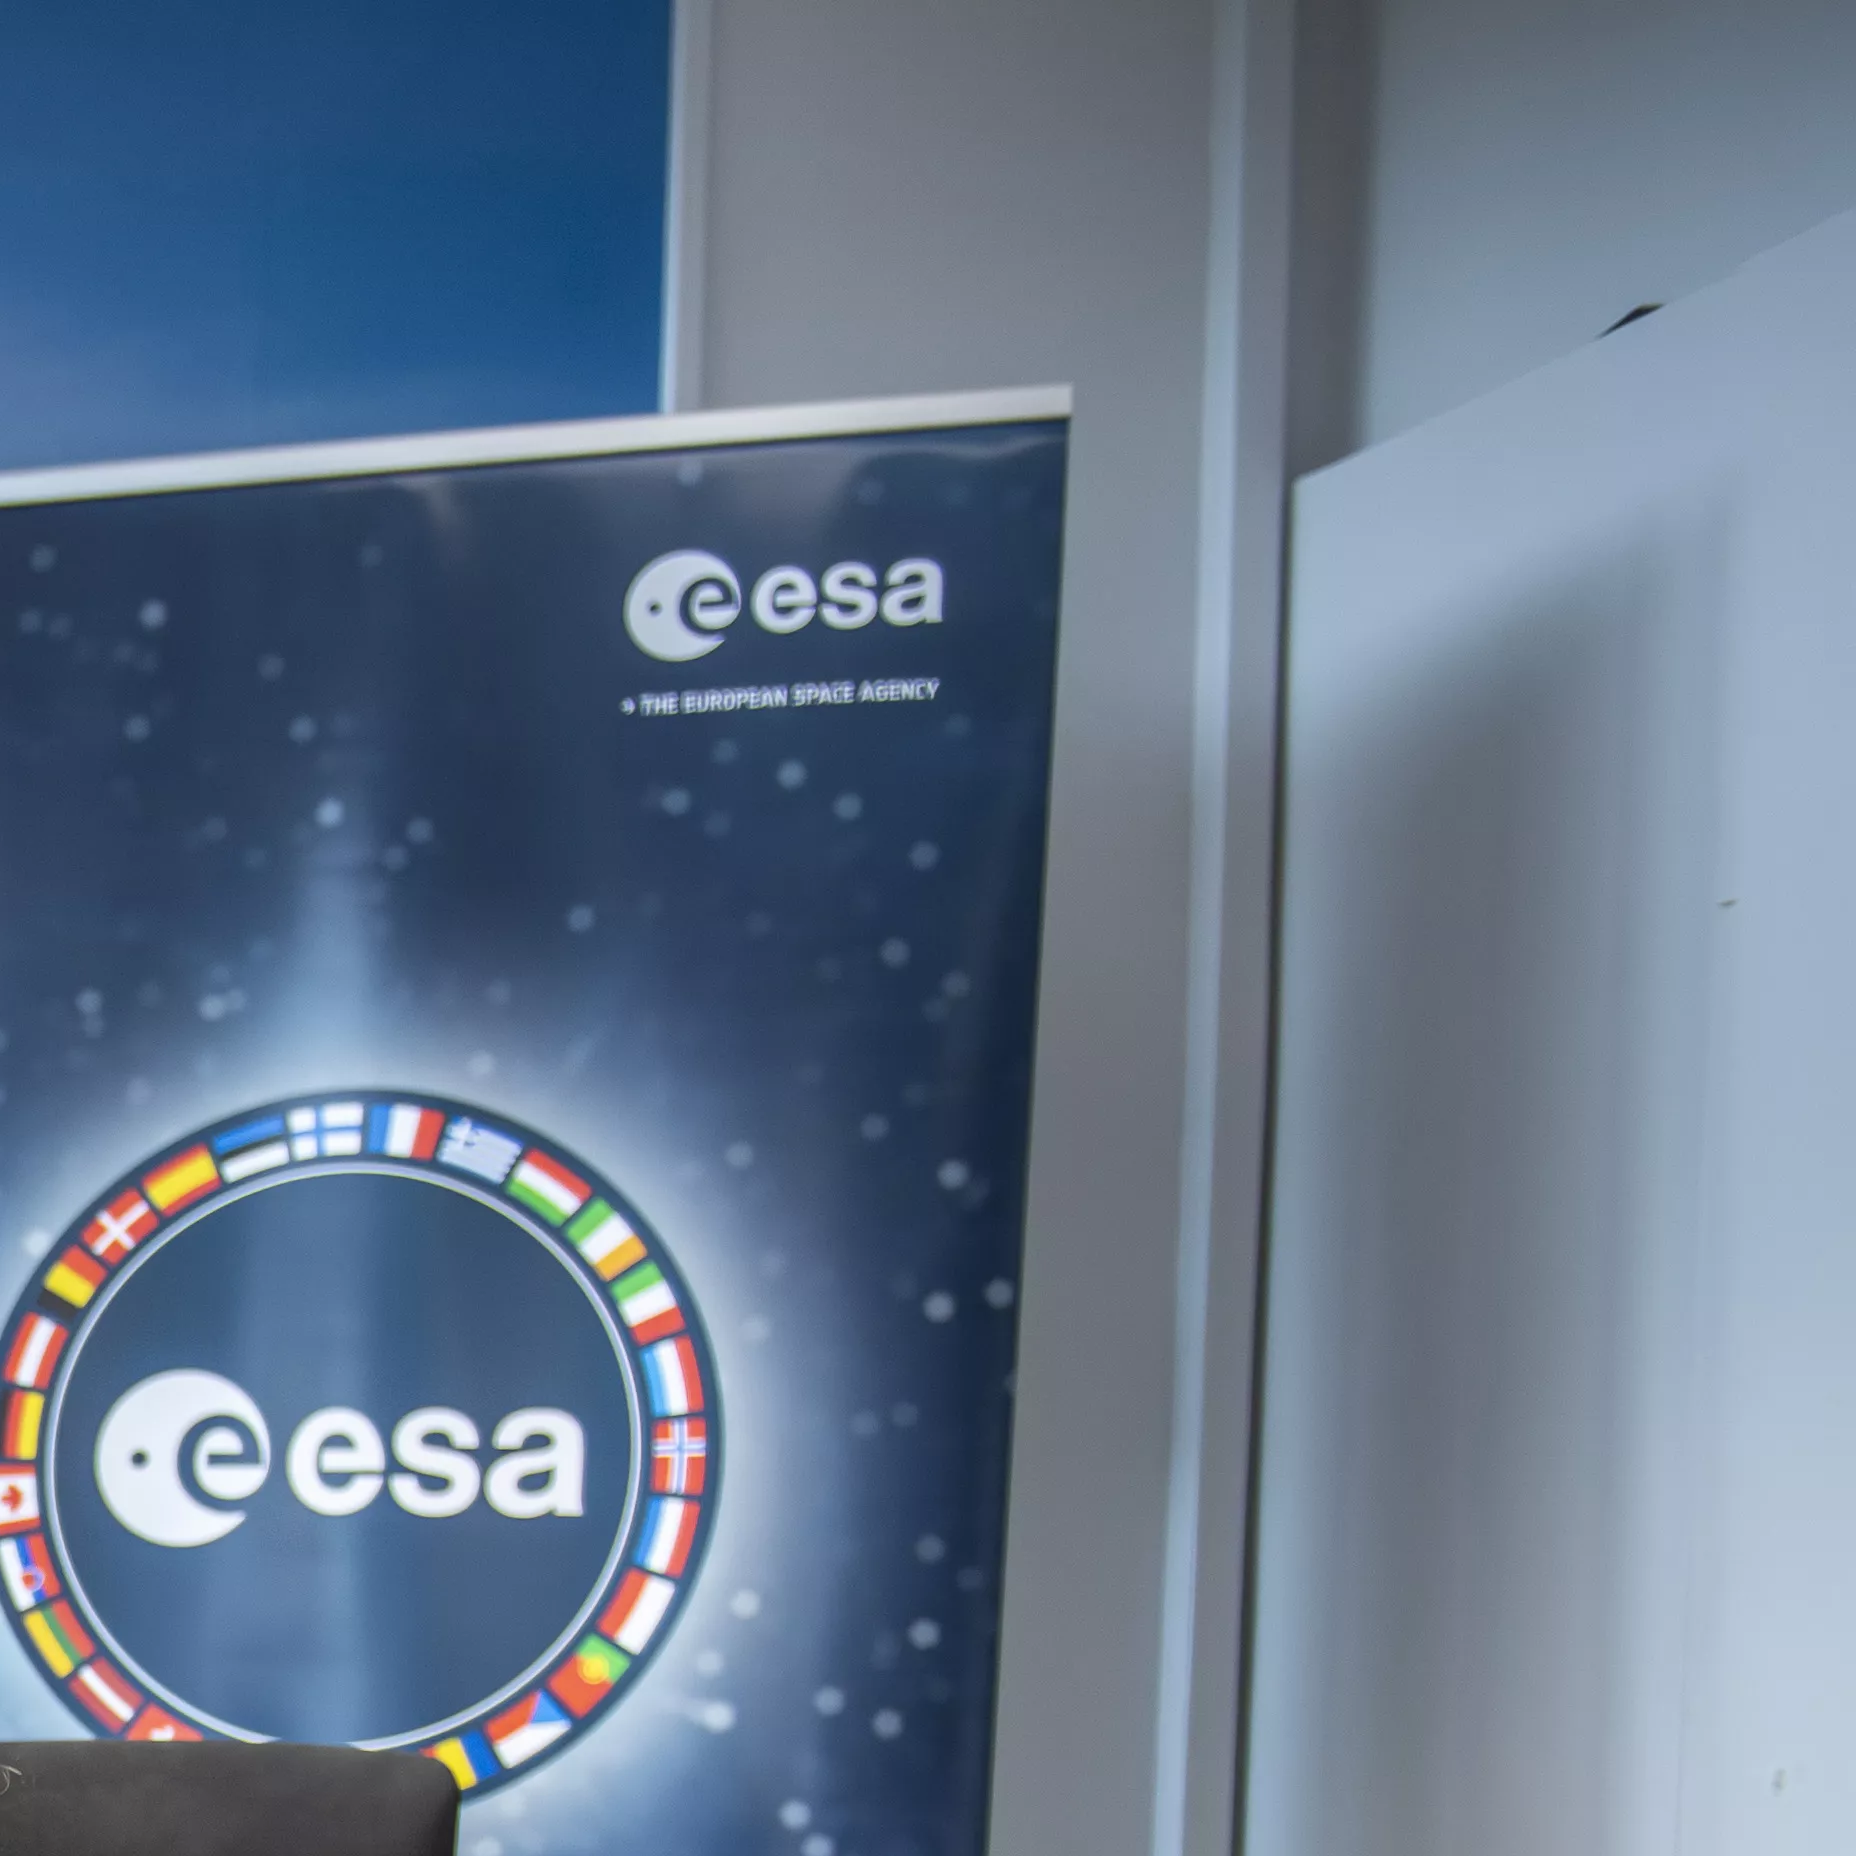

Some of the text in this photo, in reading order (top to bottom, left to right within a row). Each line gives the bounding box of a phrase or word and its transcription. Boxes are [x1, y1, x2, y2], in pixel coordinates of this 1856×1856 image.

[750, 557, 944, 635] esa
[640, 676, 941, 717] THE EUROPEAN SPACE AGENCY
[286, 1405, 587, 1521] esa
